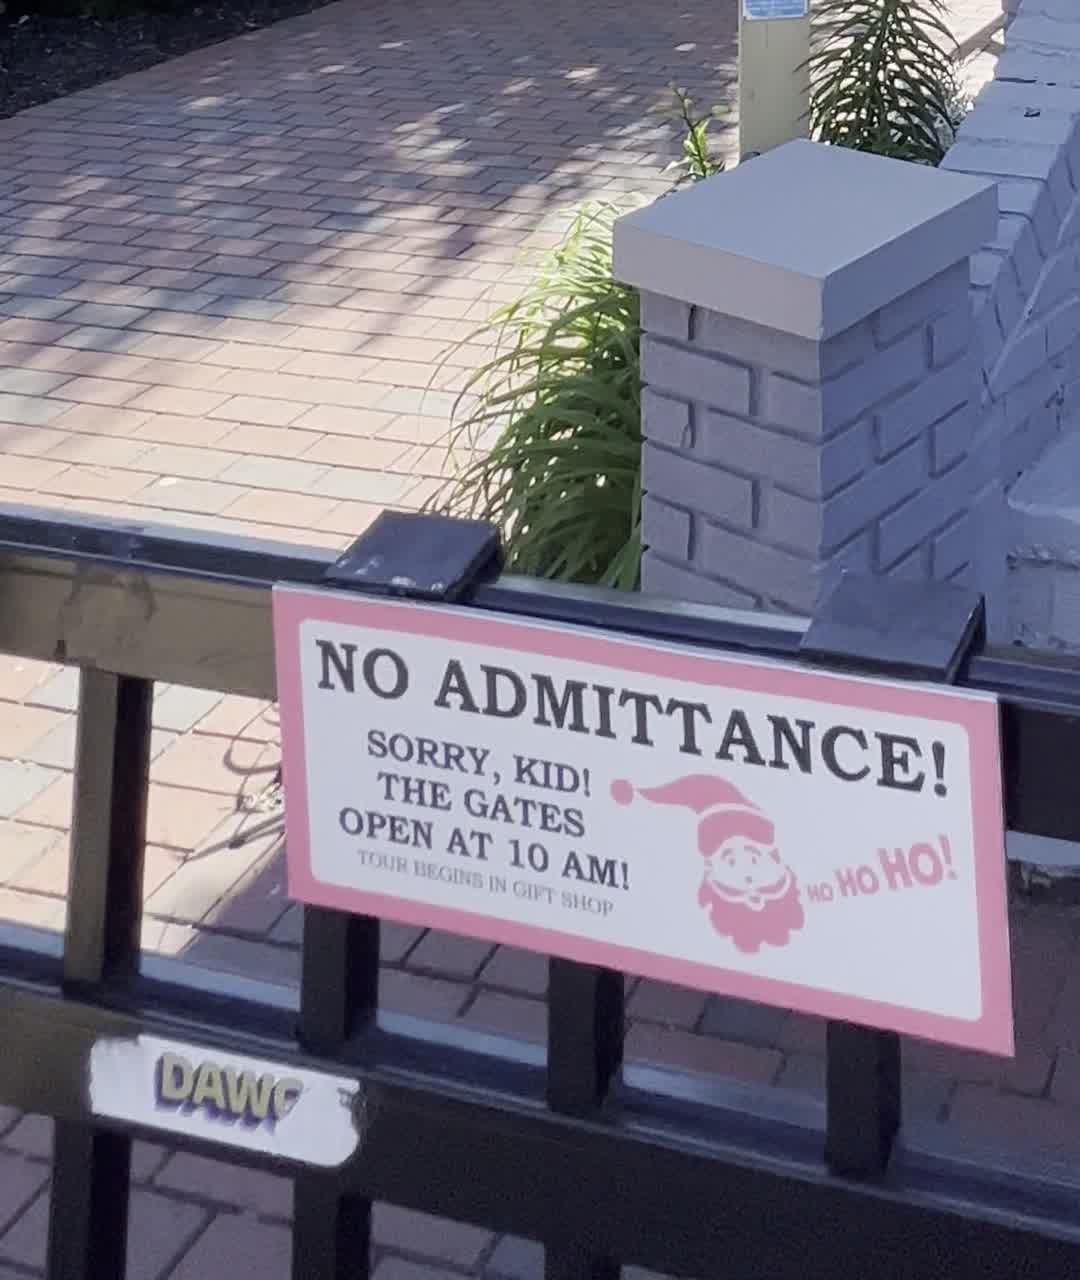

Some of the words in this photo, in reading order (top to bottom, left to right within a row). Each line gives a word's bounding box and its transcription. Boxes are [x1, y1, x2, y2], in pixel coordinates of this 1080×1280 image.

[314, 639, 409, 700] NO
[433, 658, 948, 798] ADMITTANCE!
[367, 729, 501, 785] SORRY,
[512, 754, 591, 798] KID!
[377, 771, 452, 811] THE
[463, 788, 586, 838] GATES
[338, 806, 433, 849] OPEN
[446, 827, 493, 860] AT
[508, 839, 549, 873] 10
[561, 850, 630, 890] AM!
[807, 882, 833, 903] HO
[834, 865, 881, 897] HO
[877, 833, 959, 892] HO!
[357, 849, 408, 873] TOUR
[413, 858, 484, 890] BEGINS
[488, 875, 508, 894] IN
[512, 879, 555, 904] GIFT
[560, 892, 614, 918] SHOP
